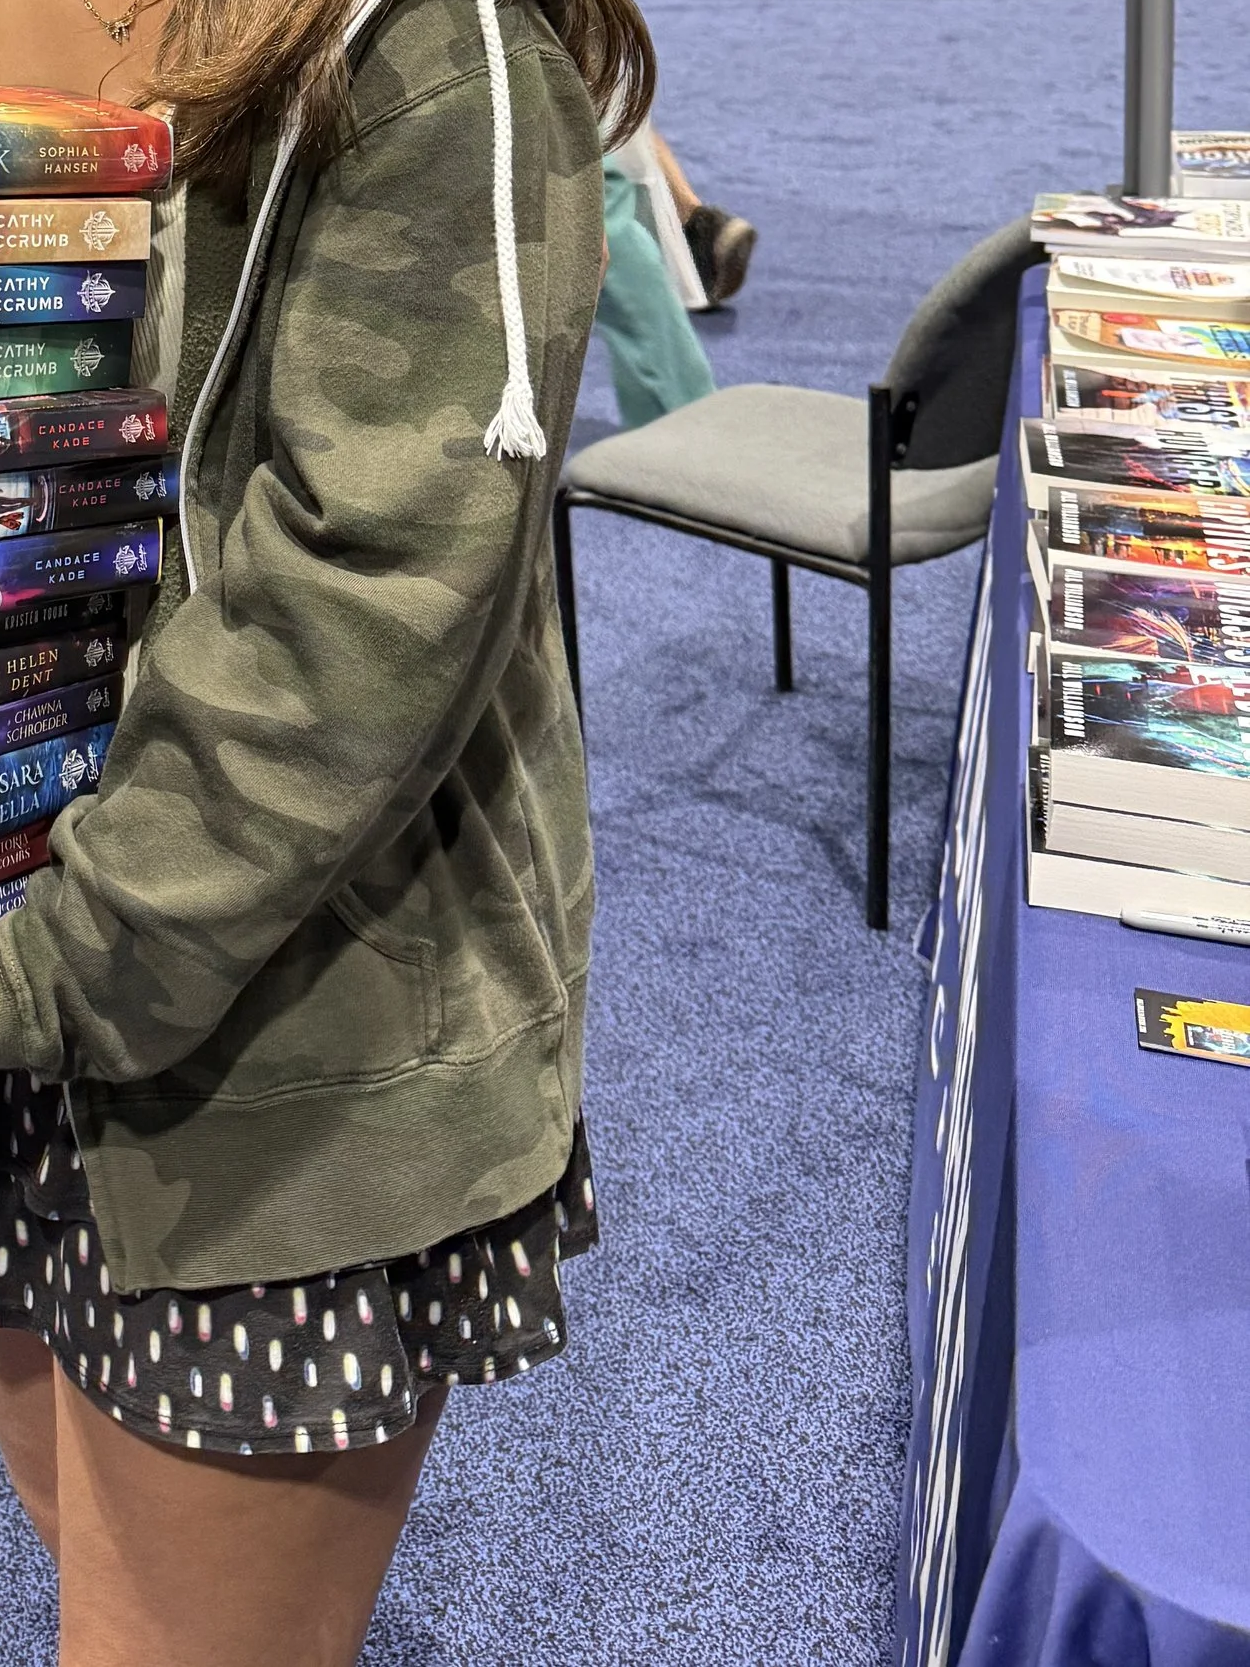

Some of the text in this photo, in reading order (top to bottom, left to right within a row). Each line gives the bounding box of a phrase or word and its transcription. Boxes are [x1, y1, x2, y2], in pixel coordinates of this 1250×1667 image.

[39, 146, 88, 159] SOPHIA
[44, 161, 99, 175] HANSEN
[1169, 377, 1239, 428] THIRST
[38, 420, 106, 436] CANDACE
[52, 434, 93, 449] KADE
[1155, 428, 1222, 489] HUNGER
[58, 477, 122, 495] CANDACE
[71, 493, 108, 507] KADE
[35, 551, 101, 572] CANDACE
[48, 568, 88, 584] KADE
[1064, 568, 1084, 630] JILL WILLIAMSON
[7, 648, 59, 674] HELEN
[11, 668, 54, 692] DENT
[1061, 661, 1086, 738] JILL WILLIAMSON
[14, 699, 63, 724] CHAWNA
[6, 712, 68, 744] SCHROEDER
